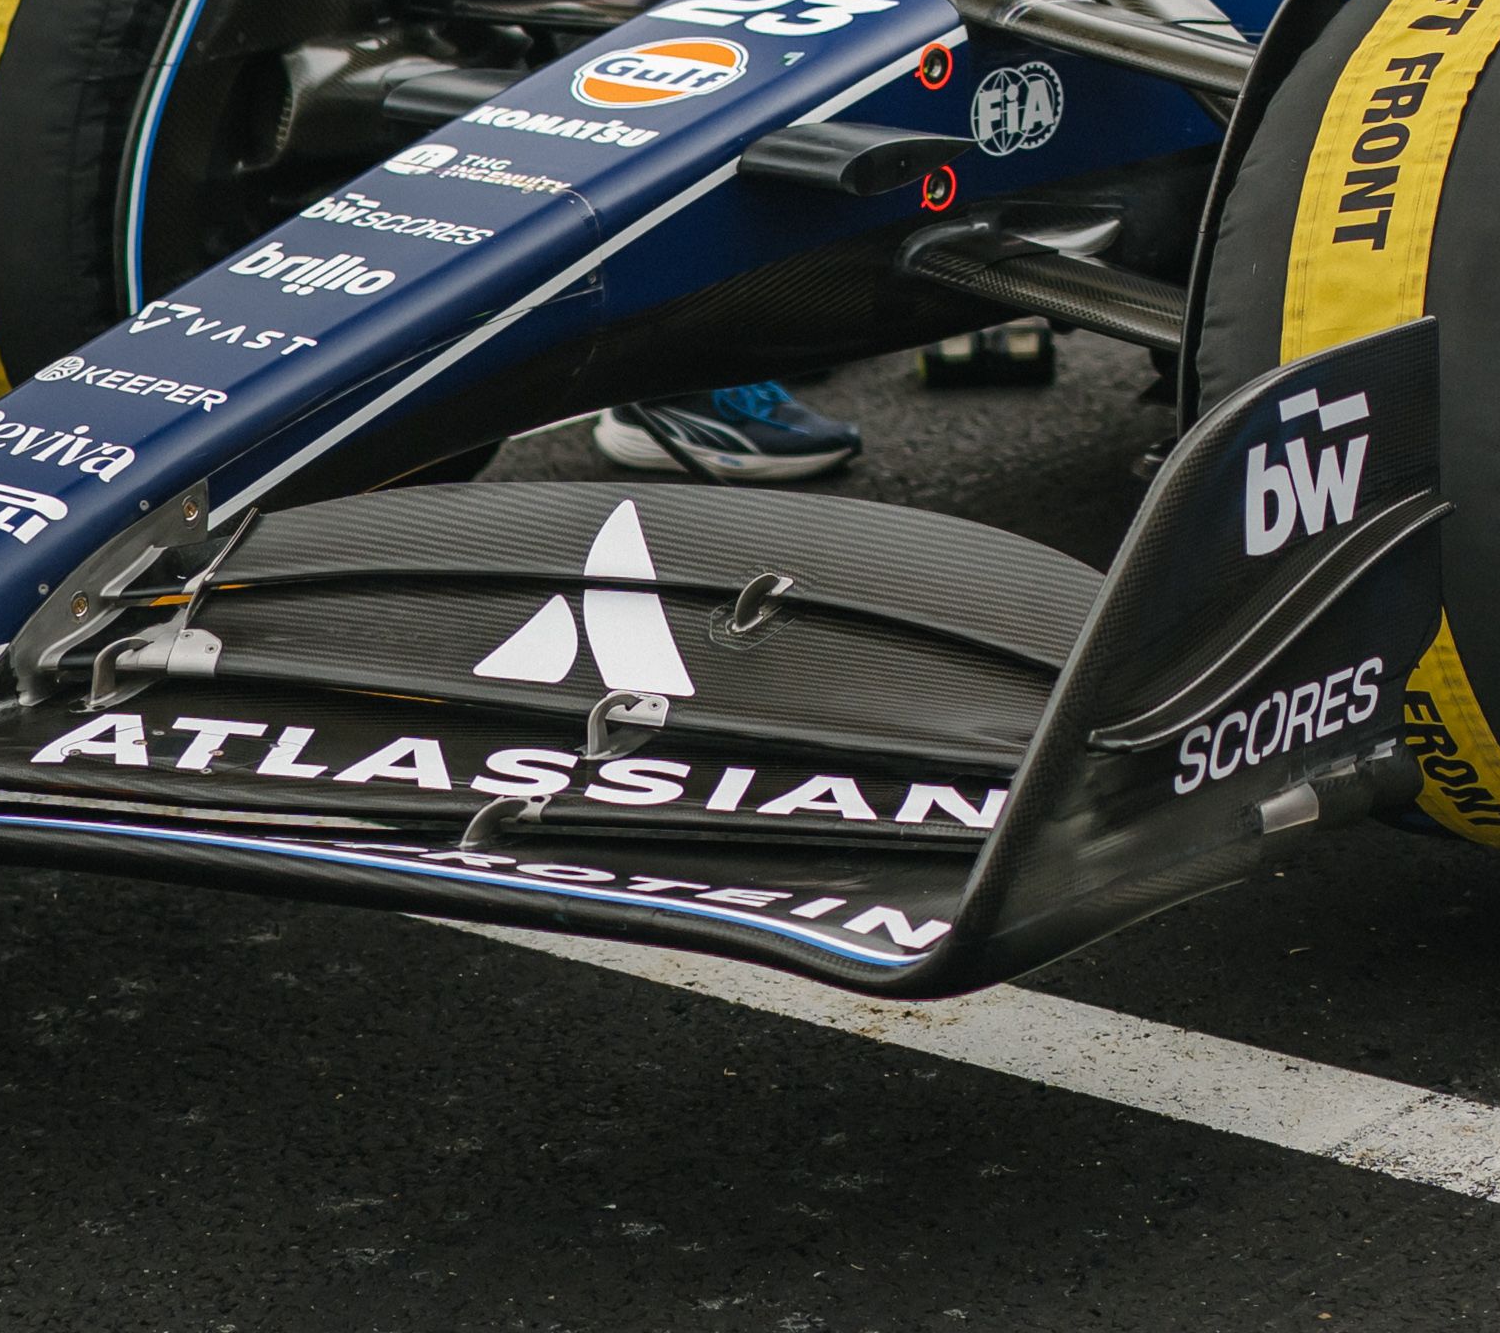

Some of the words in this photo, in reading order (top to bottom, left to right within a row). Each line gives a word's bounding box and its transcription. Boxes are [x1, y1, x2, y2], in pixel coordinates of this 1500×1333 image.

[594, 55, 735, 90] Gulf
[463, 105, 660, 148] KOMATSU
[459, 154, 512, 171] THG
[1333, 52, 1444, 252] FRONT
[186, 318, 317, 356] VAST
[74, 364, 229, 413] KEEPER
[1174, 656, 1384, 795] SCORES
[31, 712, 1009, 830] ATLASSIAN
